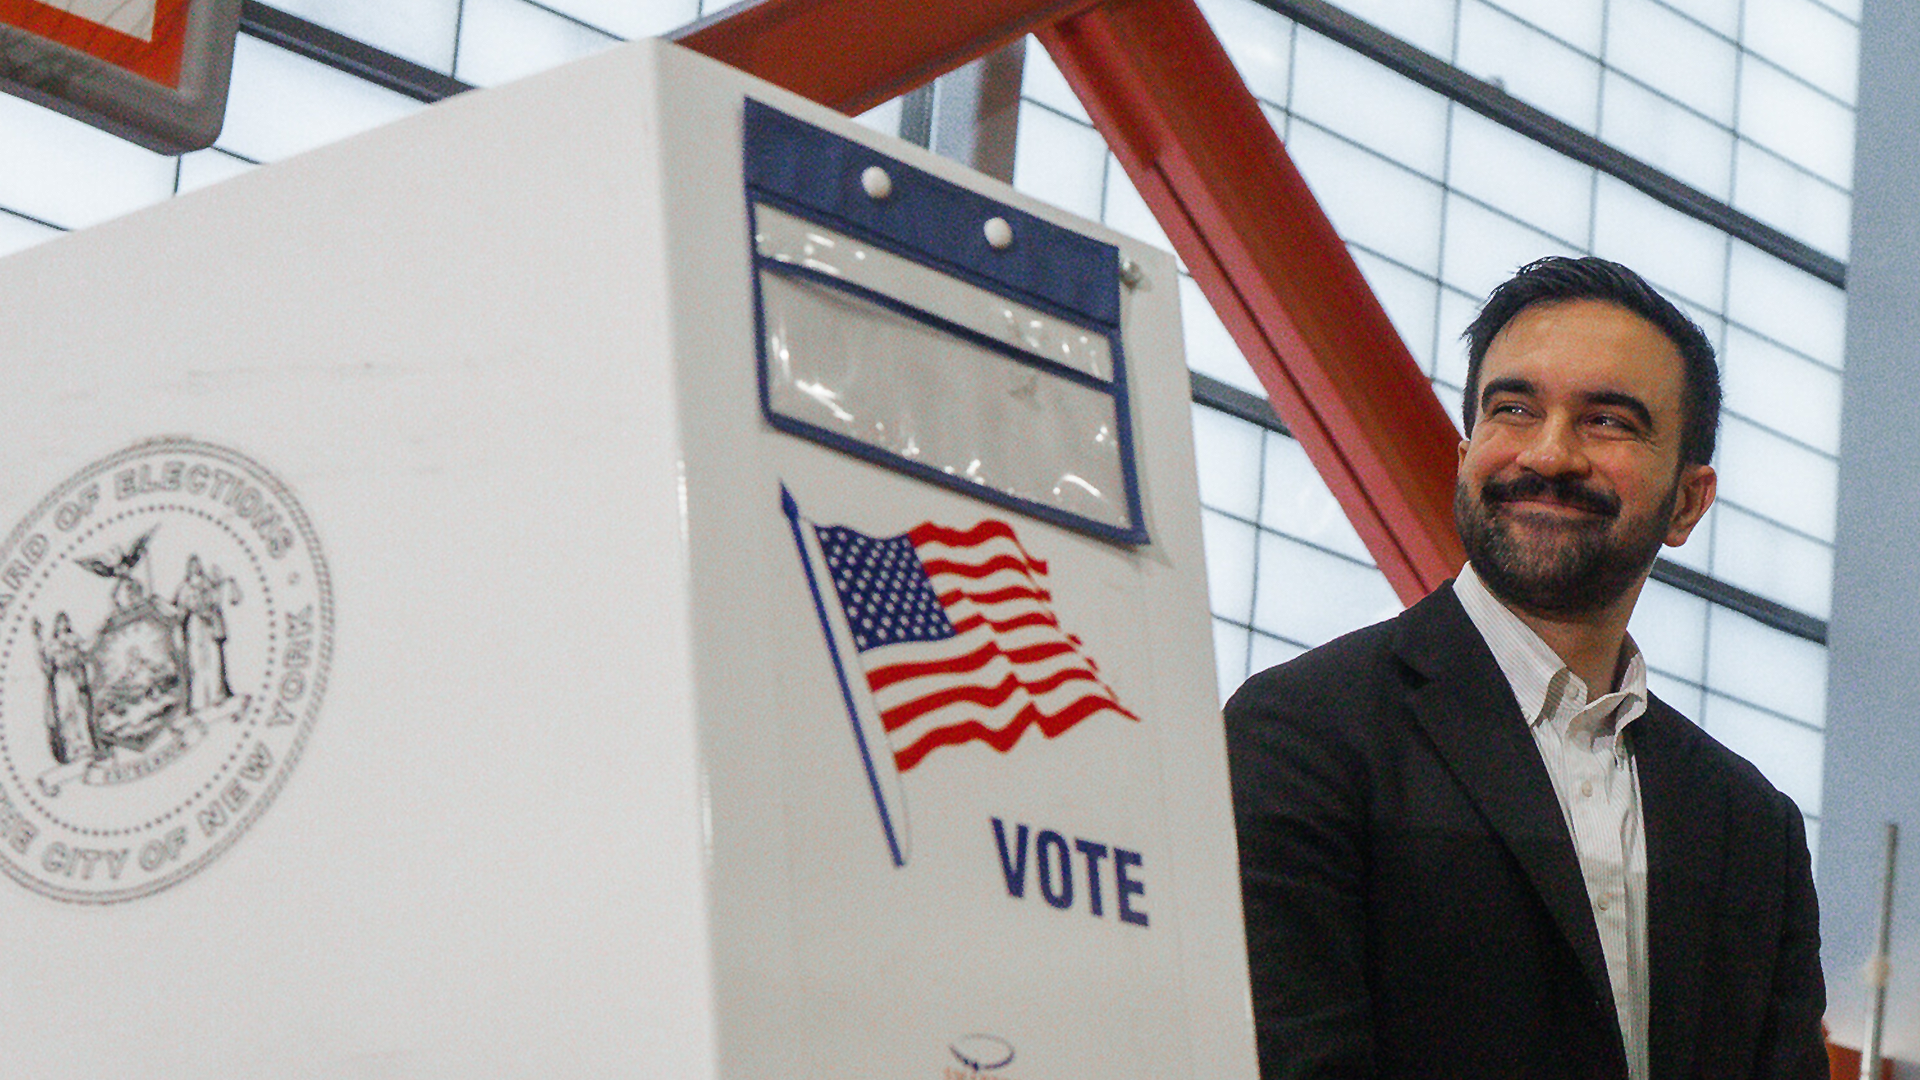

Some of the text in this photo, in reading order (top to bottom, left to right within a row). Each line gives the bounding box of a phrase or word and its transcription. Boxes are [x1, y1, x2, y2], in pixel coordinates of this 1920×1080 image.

[54, 481, 101, 533] OF
[113, 460, 295, 560] ELECTIONS
[0, 780, 40, 856] HE
[42, 840, 130, 881] CITY
[138, 826, 187, 873] OF
[196, 740, 274, 838] NEW
[264, 602, 315, 727] YORK
[989, 815, 1150, 927] VOTE
